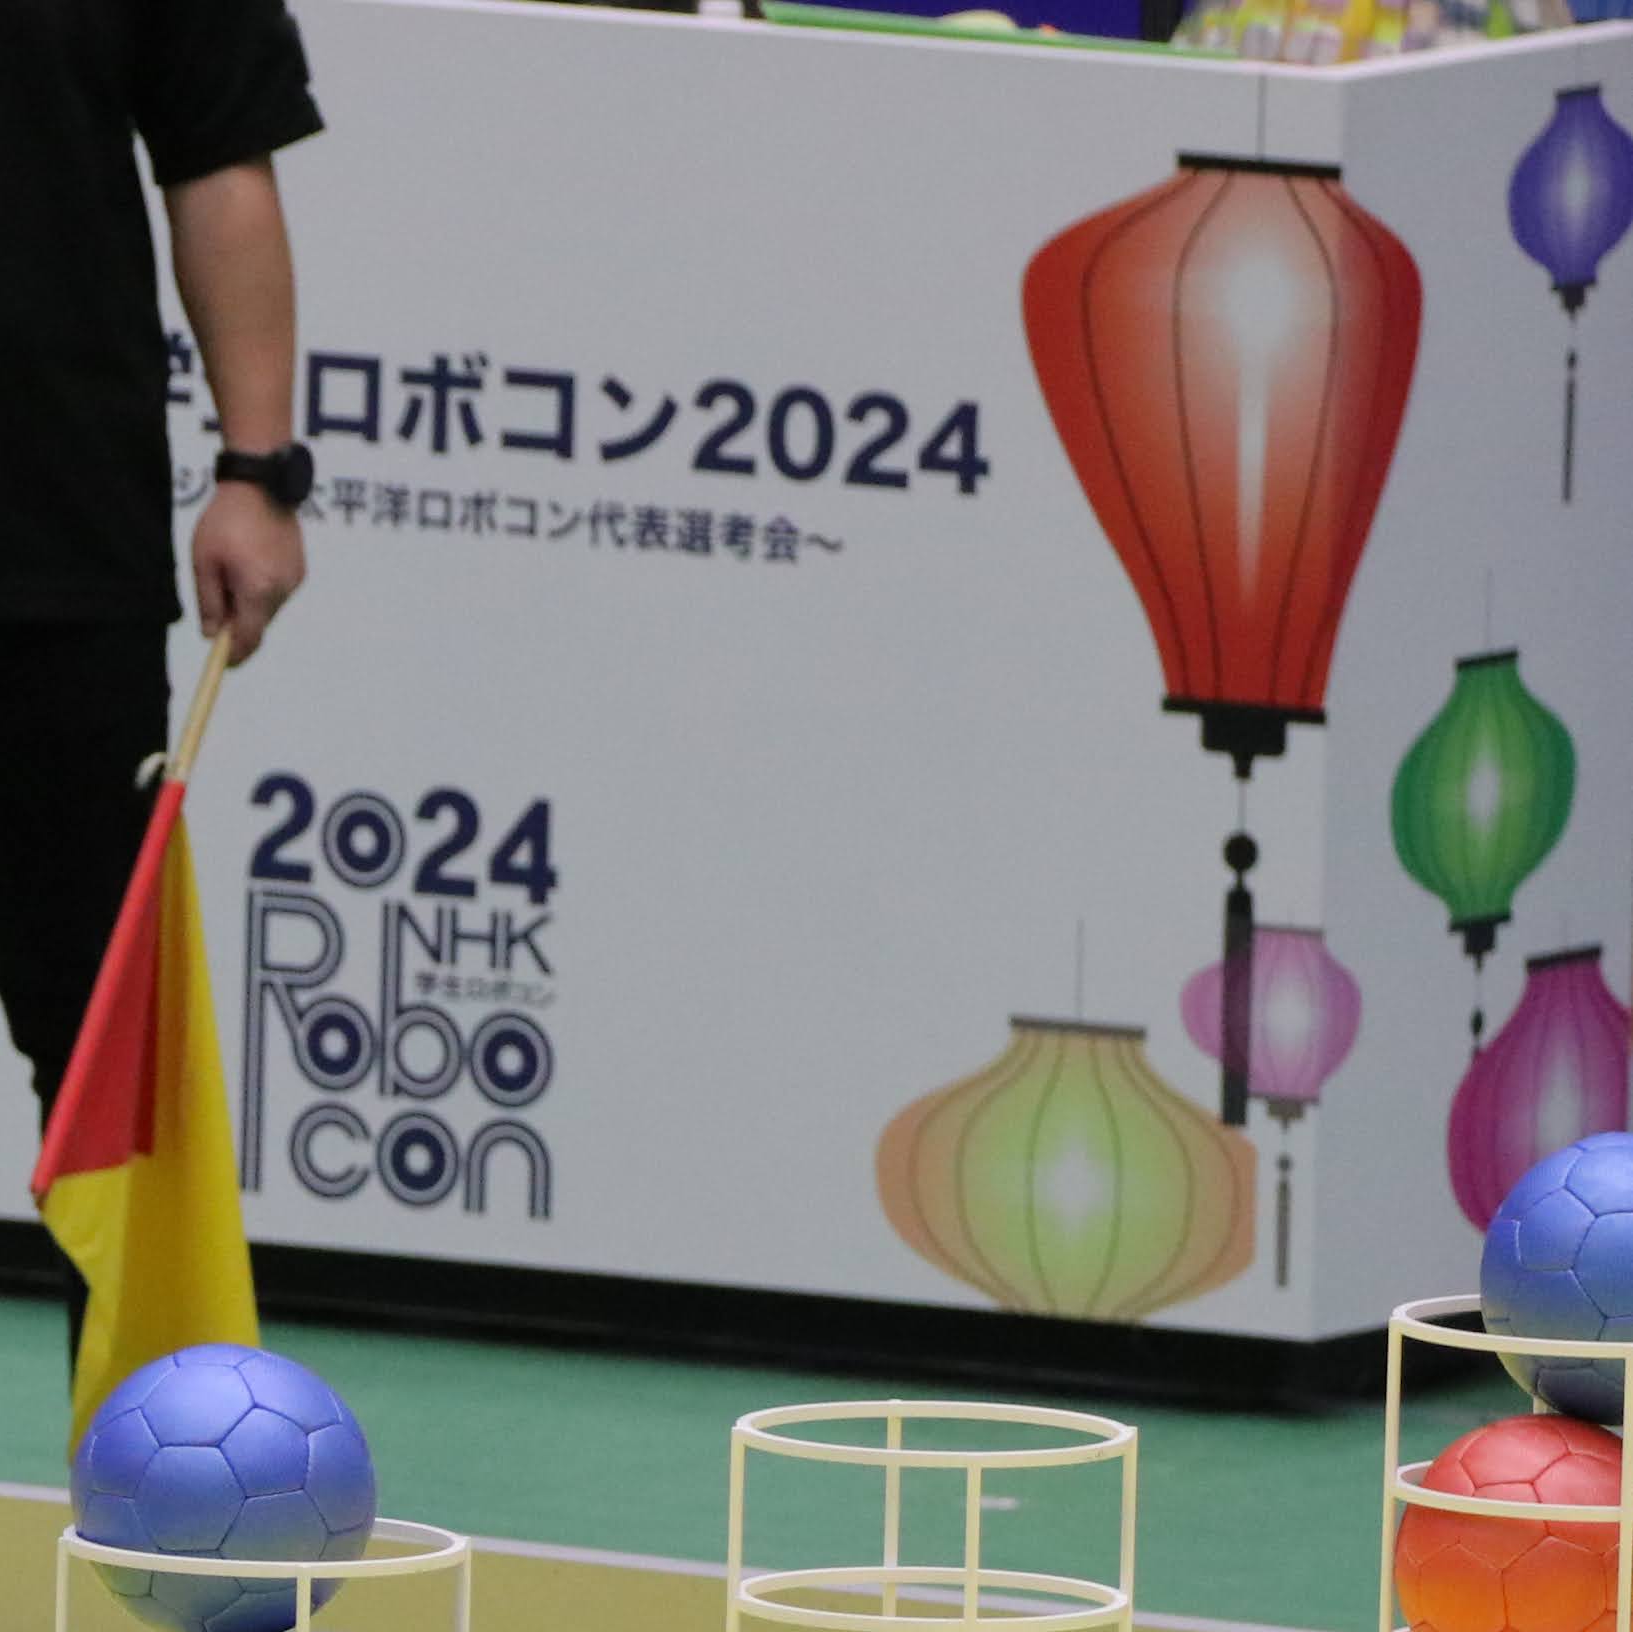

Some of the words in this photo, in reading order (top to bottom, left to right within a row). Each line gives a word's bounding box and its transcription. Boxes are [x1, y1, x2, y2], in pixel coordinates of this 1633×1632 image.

[167, 332, 990, 496] ロボコン2024
[249, 772, 558, 905] 2024
[383, 901, 553, 976] NHK
